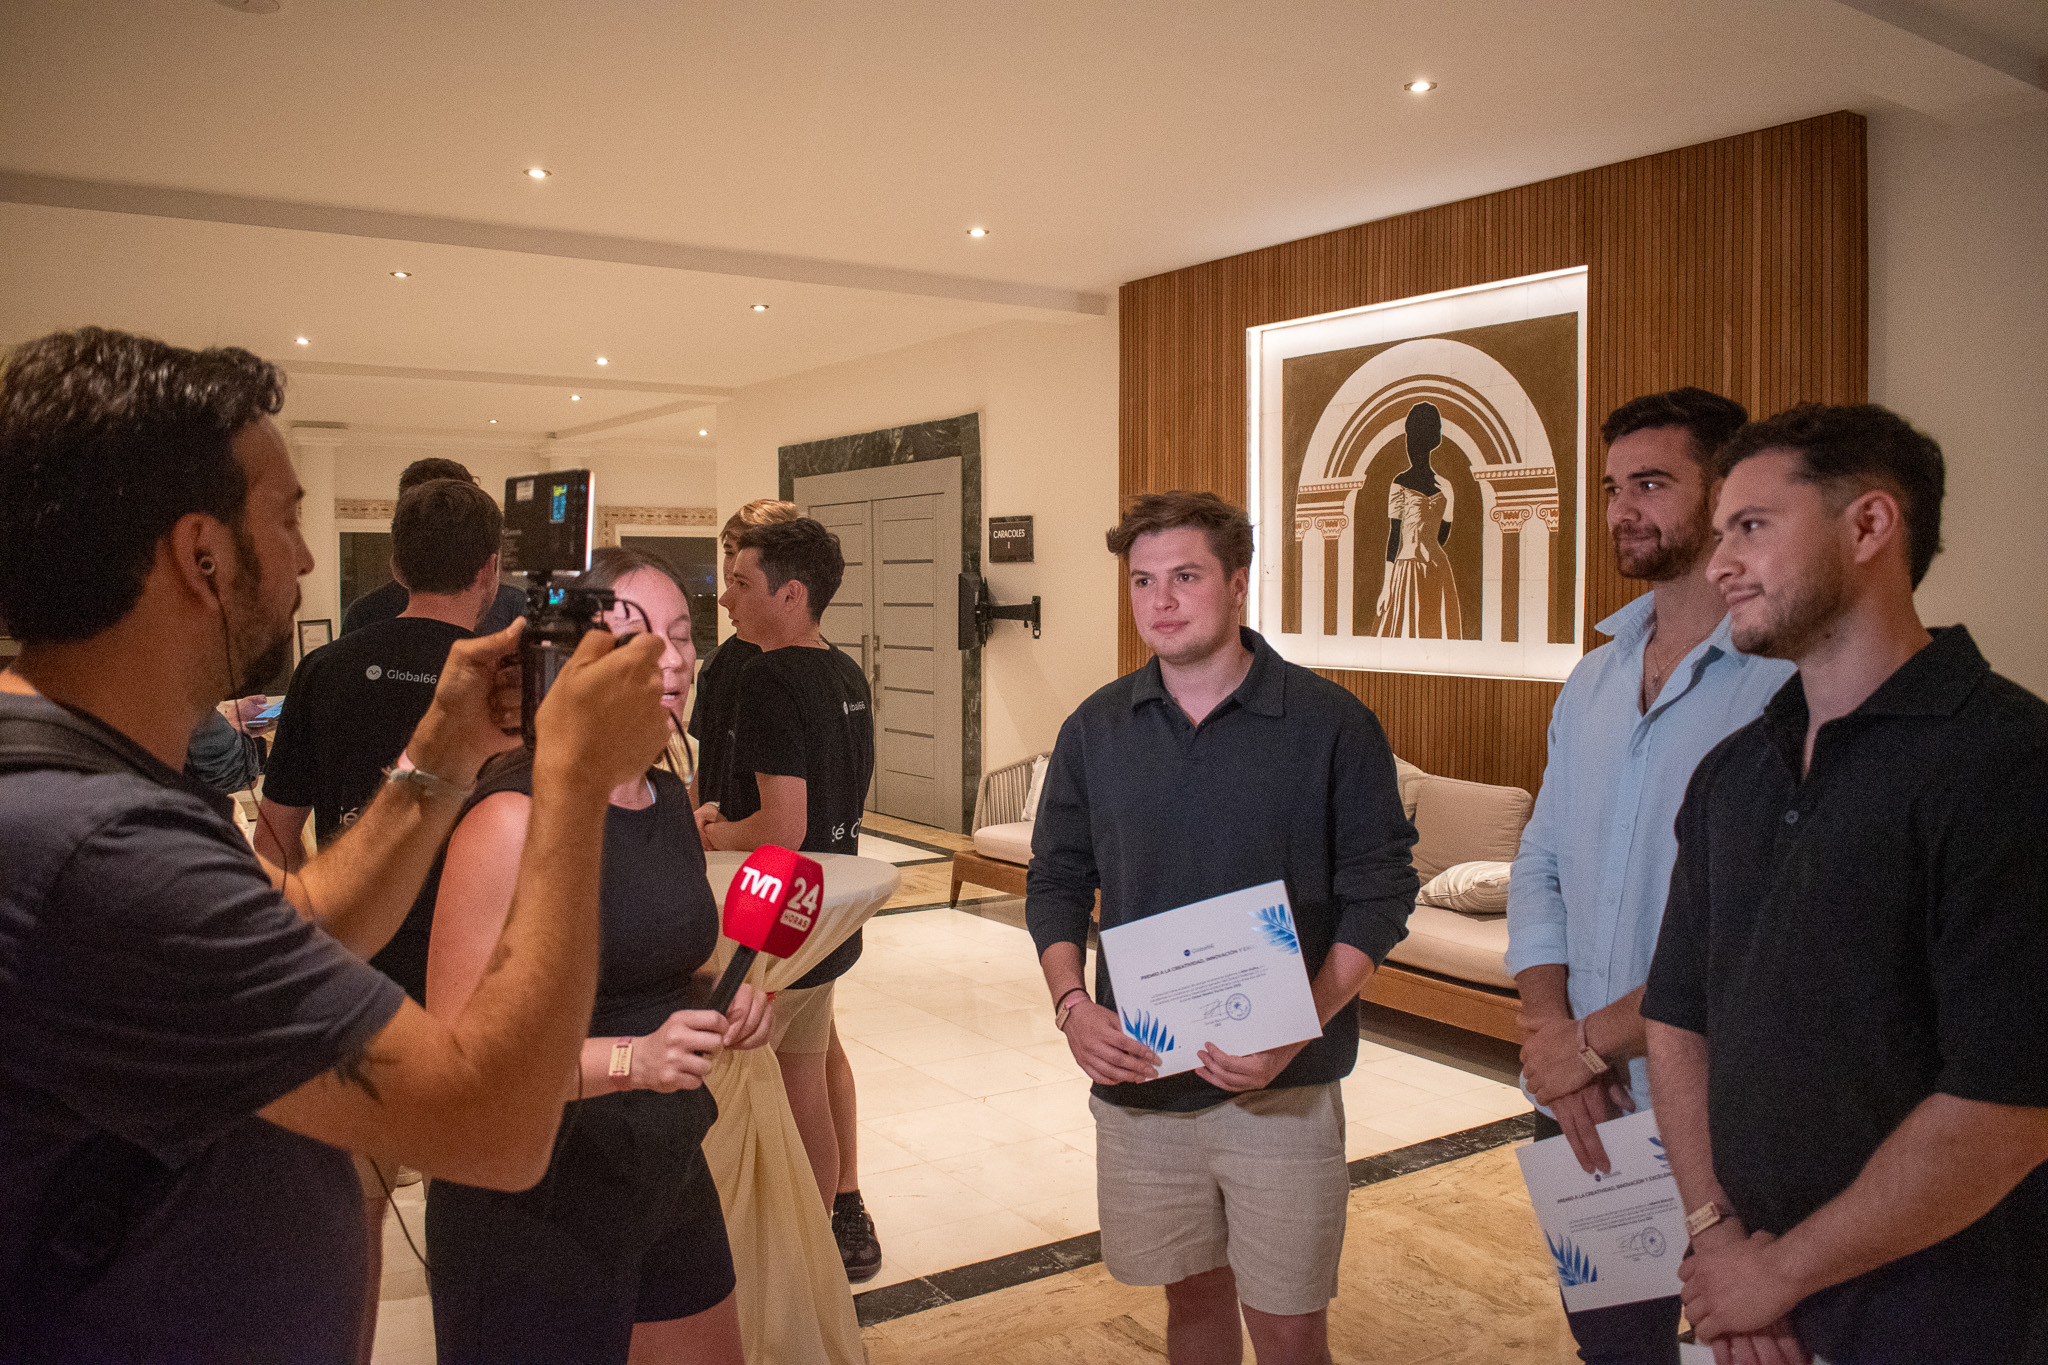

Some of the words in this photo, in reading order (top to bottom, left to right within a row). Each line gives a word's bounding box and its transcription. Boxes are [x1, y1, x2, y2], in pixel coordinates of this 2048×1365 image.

[993, 529, 1025, 539] CARACOLES
[387, 669, 437, 684] Global66
[787, 877, 819, 915] 24
[784, 914, 807, 929] HORAS
